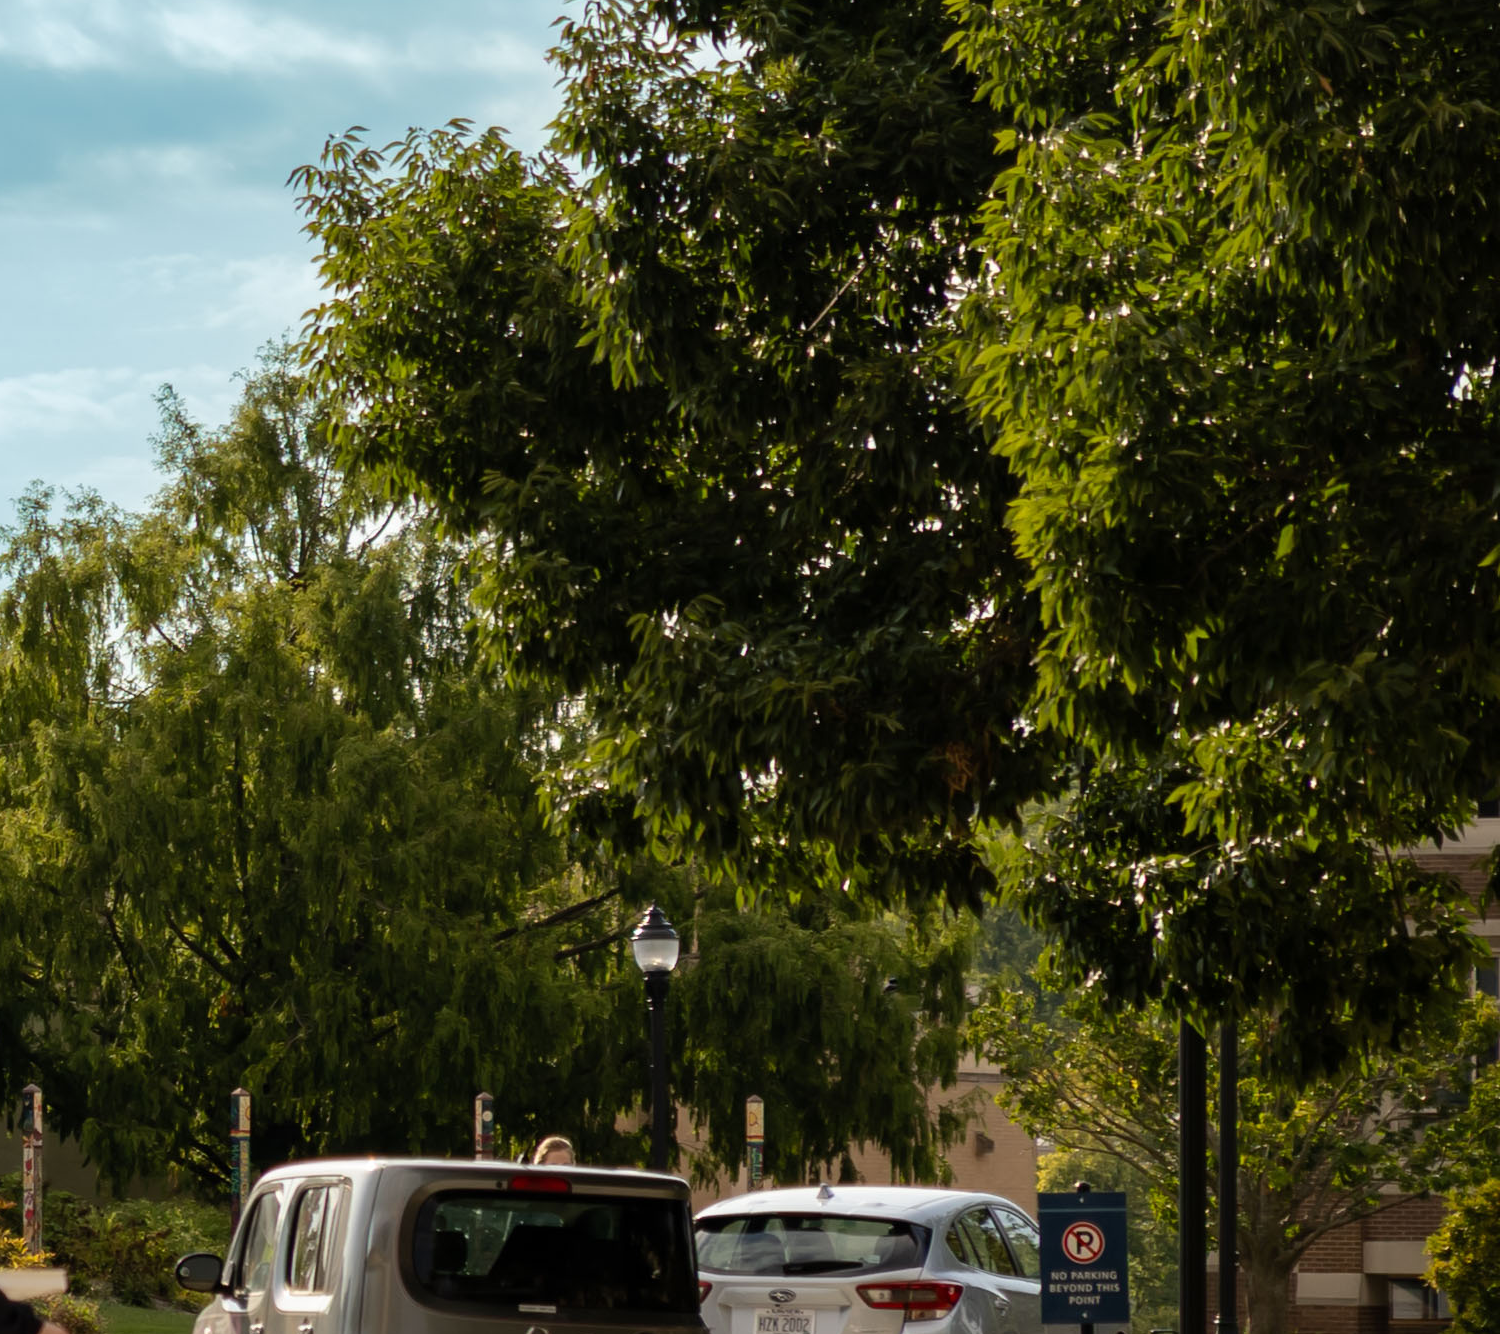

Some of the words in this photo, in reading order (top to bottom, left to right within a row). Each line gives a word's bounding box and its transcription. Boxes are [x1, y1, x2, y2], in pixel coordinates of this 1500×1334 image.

[1051, 1271, 1067, 1280] NO
[1071, 1271, 1117, 1280] PARKING
[1049, 1283, 1093, 1293] BEYOND
[1096, 1283, 1120, 1292] THIS
[1069, 1296, 1101, 1305] POINT
